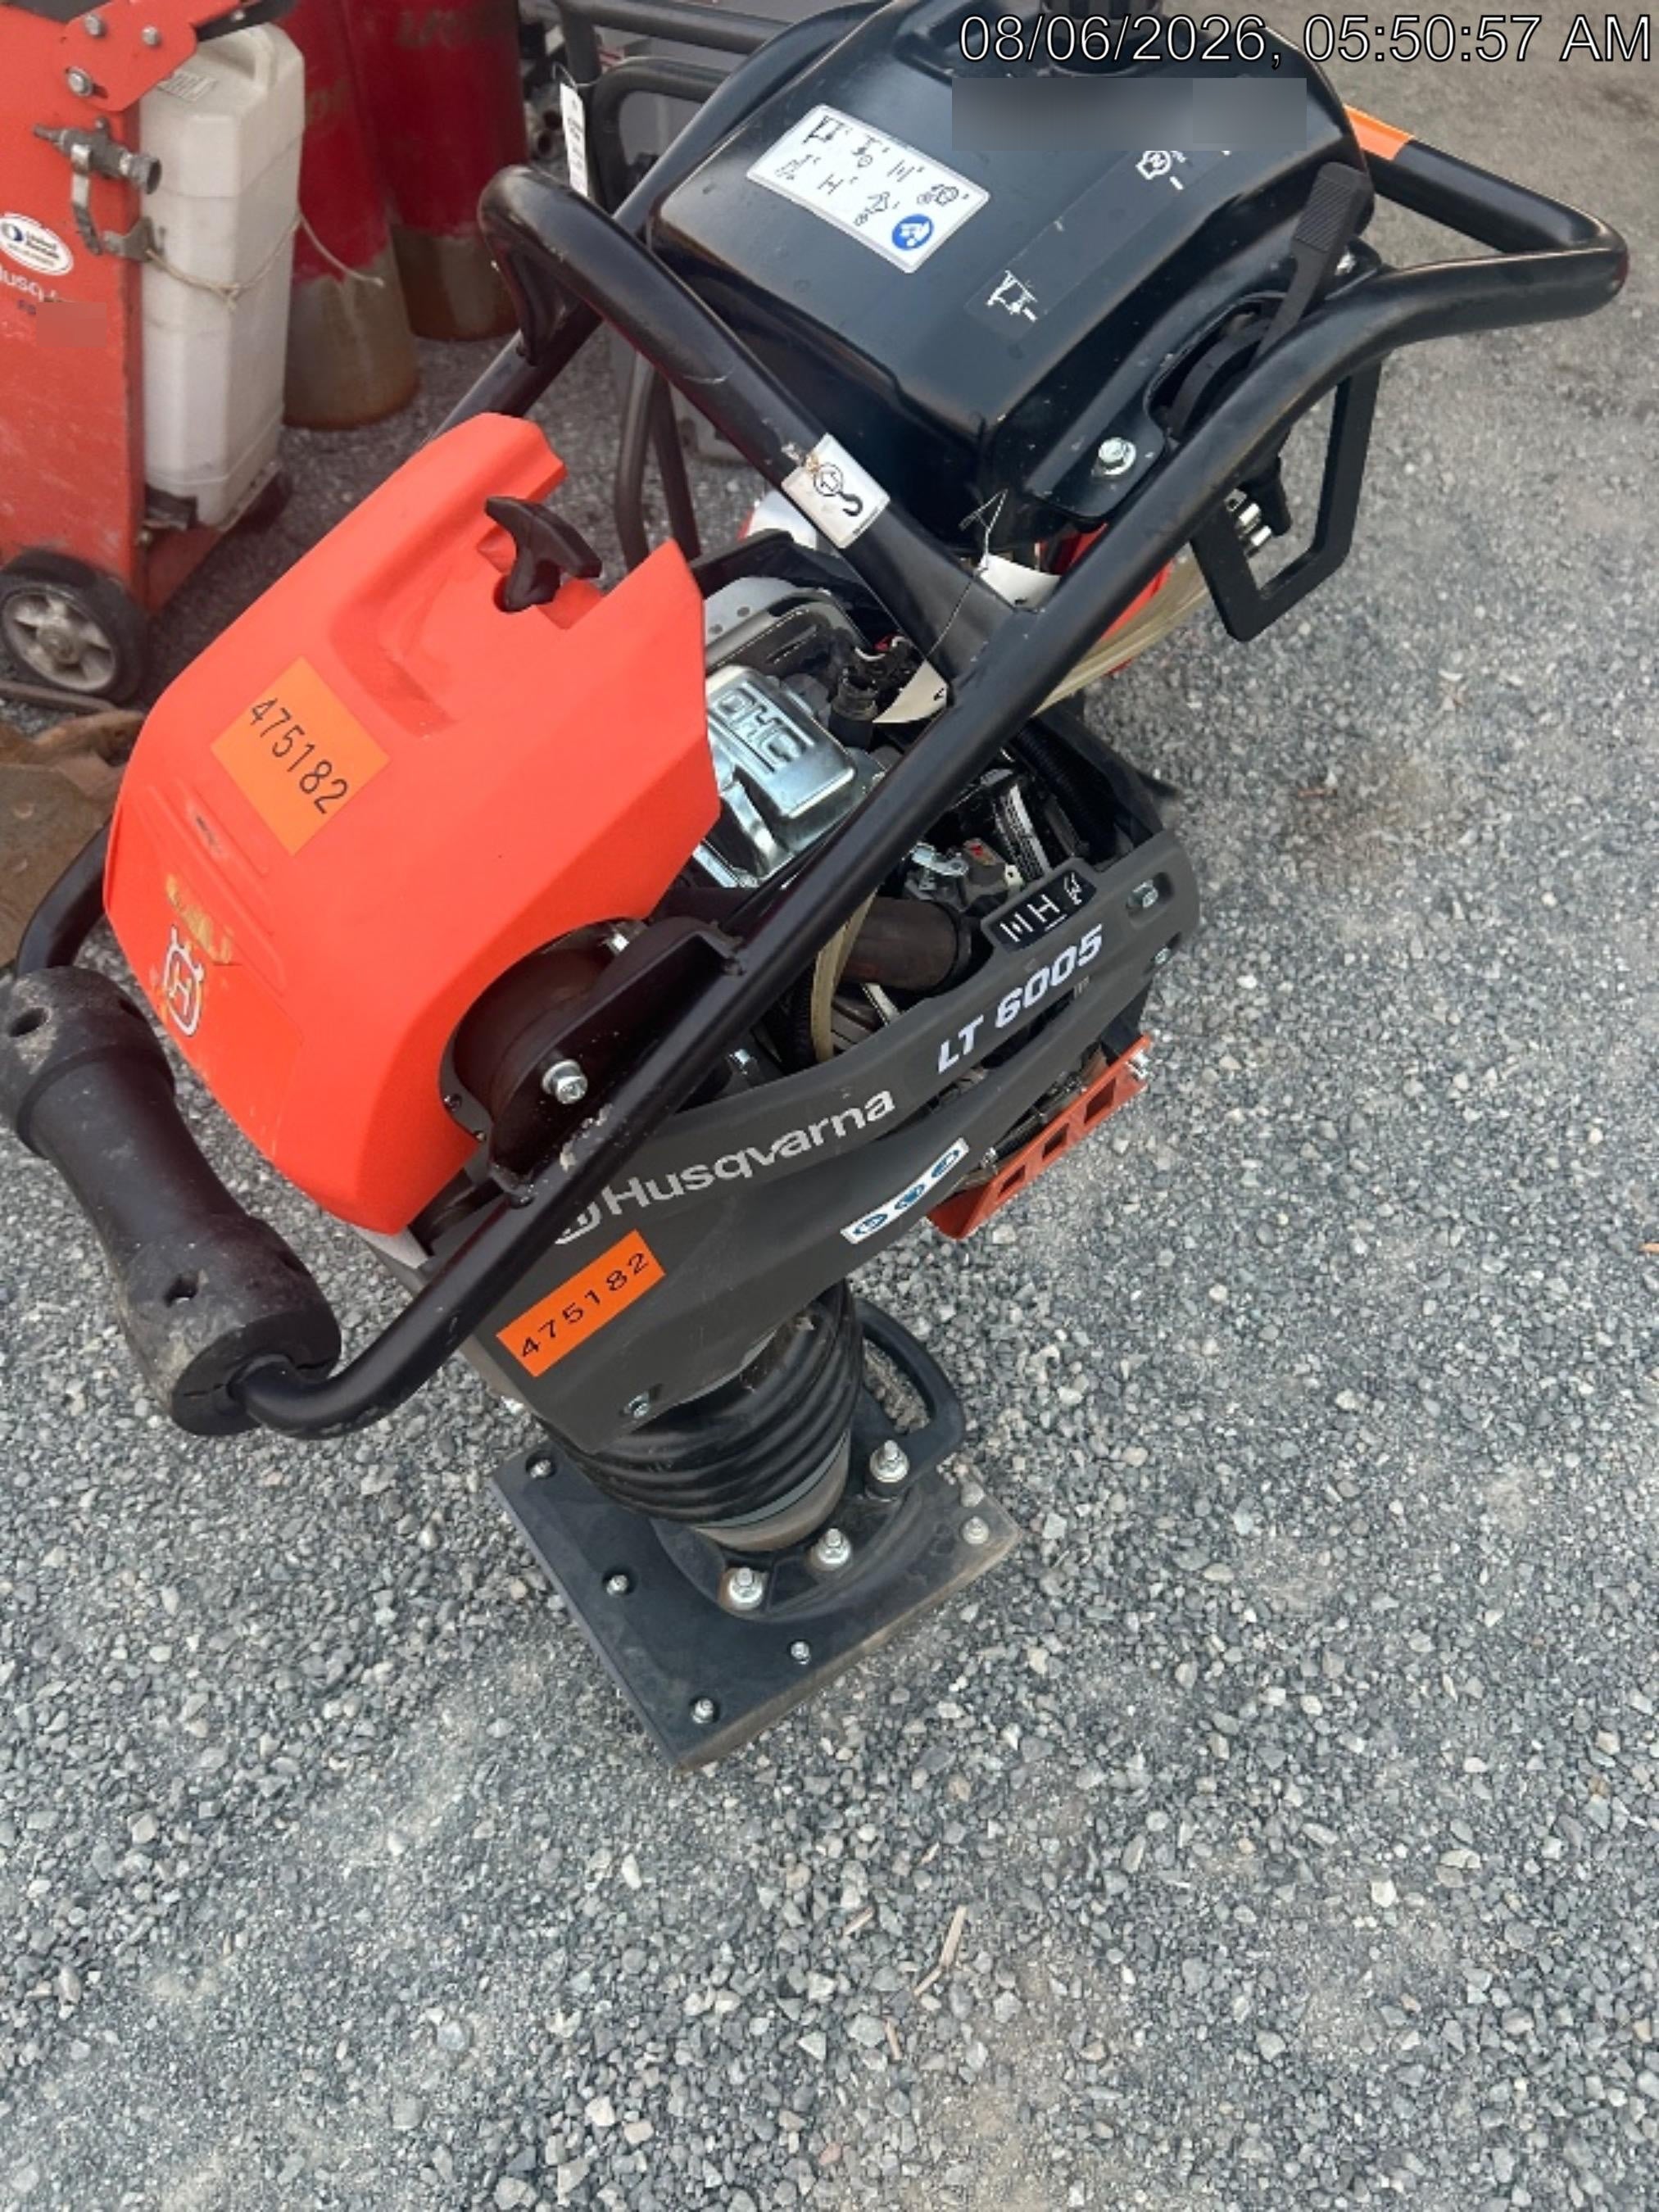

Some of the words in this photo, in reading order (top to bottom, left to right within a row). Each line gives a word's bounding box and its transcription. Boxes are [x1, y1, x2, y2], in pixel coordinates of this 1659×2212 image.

[250, 698, 348, 814] 475182
[937, 1015, 984, 1074] LT
[995, 923, 1103, 1028] 6005
[601, 1090, 895, 1215] Husqvarna
[522, 1253, 649, 1357] 475182
